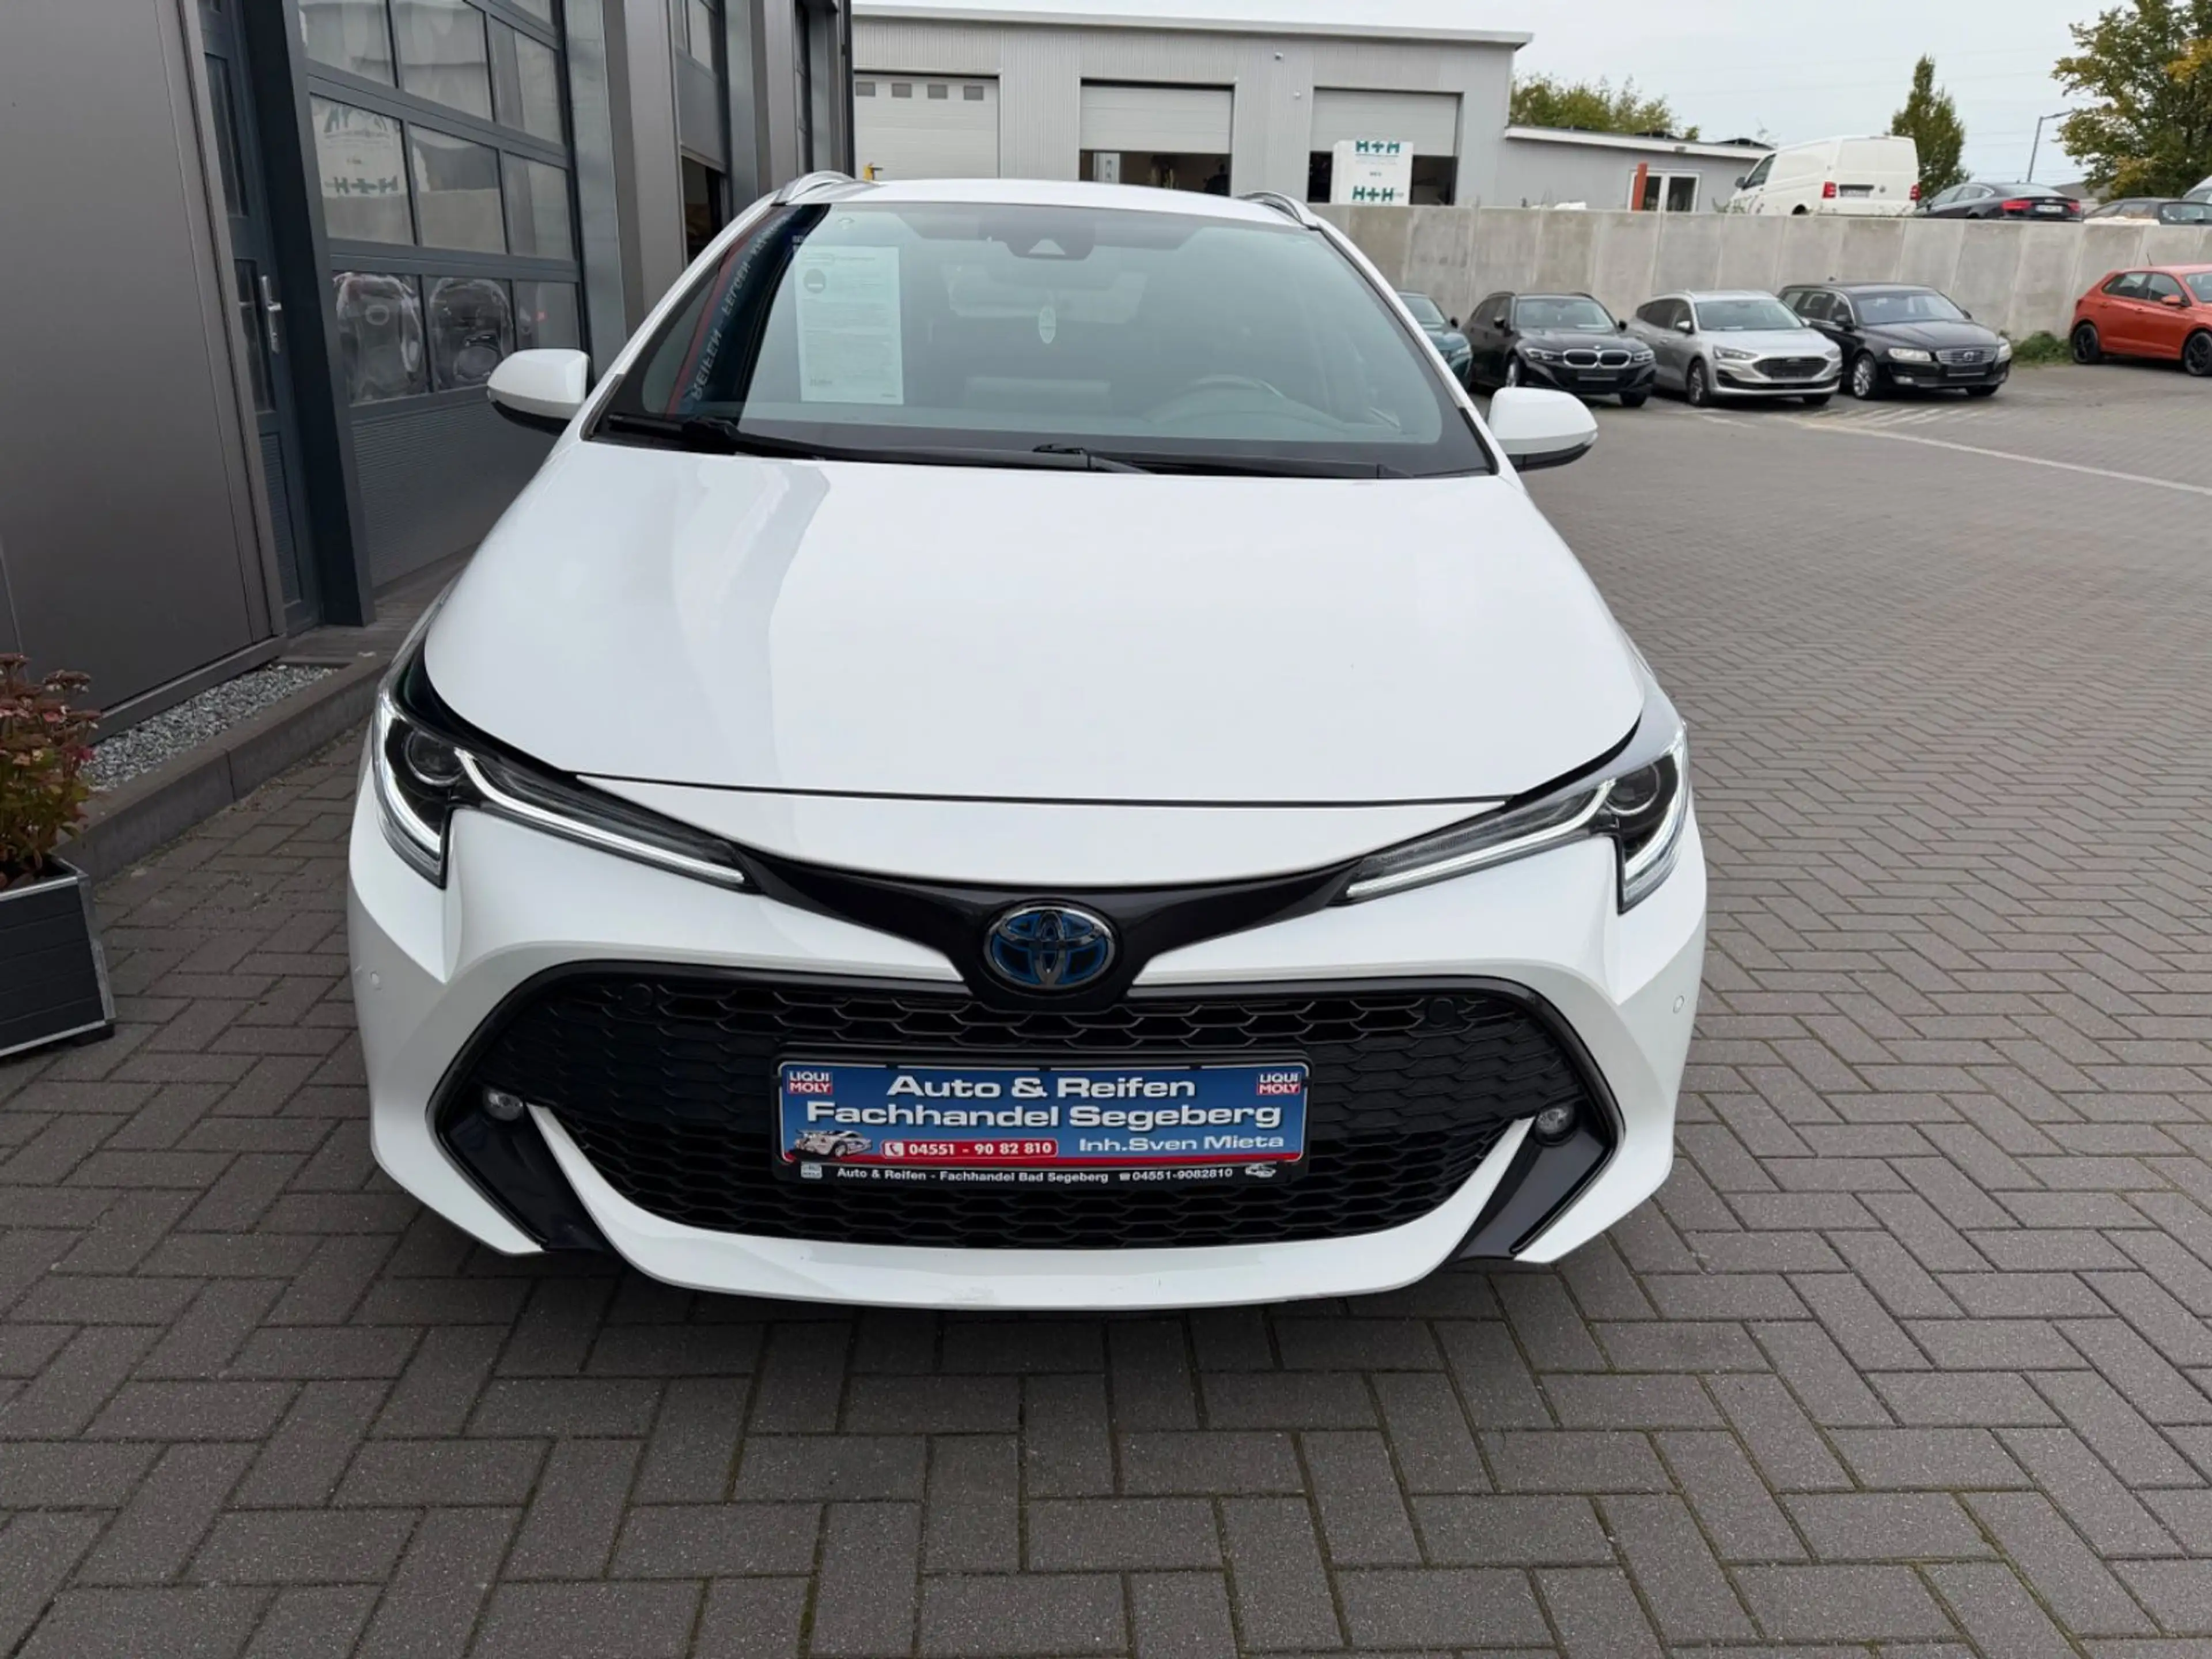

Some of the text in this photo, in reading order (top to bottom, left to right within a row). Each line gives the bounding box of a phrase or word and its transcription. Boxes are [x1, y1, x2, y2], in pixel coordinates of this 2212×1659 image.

[1352, 185, 1393, 202] H+H
[789, 1071, 830, 1081] LIQUI
[1260, 1073, 1298, 1083] LIQUI
[790, 1082, 831, 1093] MOLY
[886, 1075, 1196, 1099] Auto & Reifen
[1259, 1084, 1300, 1094] MOLY
[807, 1101, 1281, 1132] Fachhandel Segeberg
[909, 1143, 955, 1156] 04551
[974, 1143, 994, 1156] 90
[999, 1142, 1019, 1155] 82
[1024, 1142, 1052, 1154] 810
[837, 1168, 868, 1179] Auto
[871, 1169, 881, 1179] &
[885, 1169, 926, 1180] Reifen
[940, 1171, 1015, 1181] Fachhandel
[1019, 1172, 1043, 1181] Bad
[1047, 1172, 1108, 1184] Segeberg
